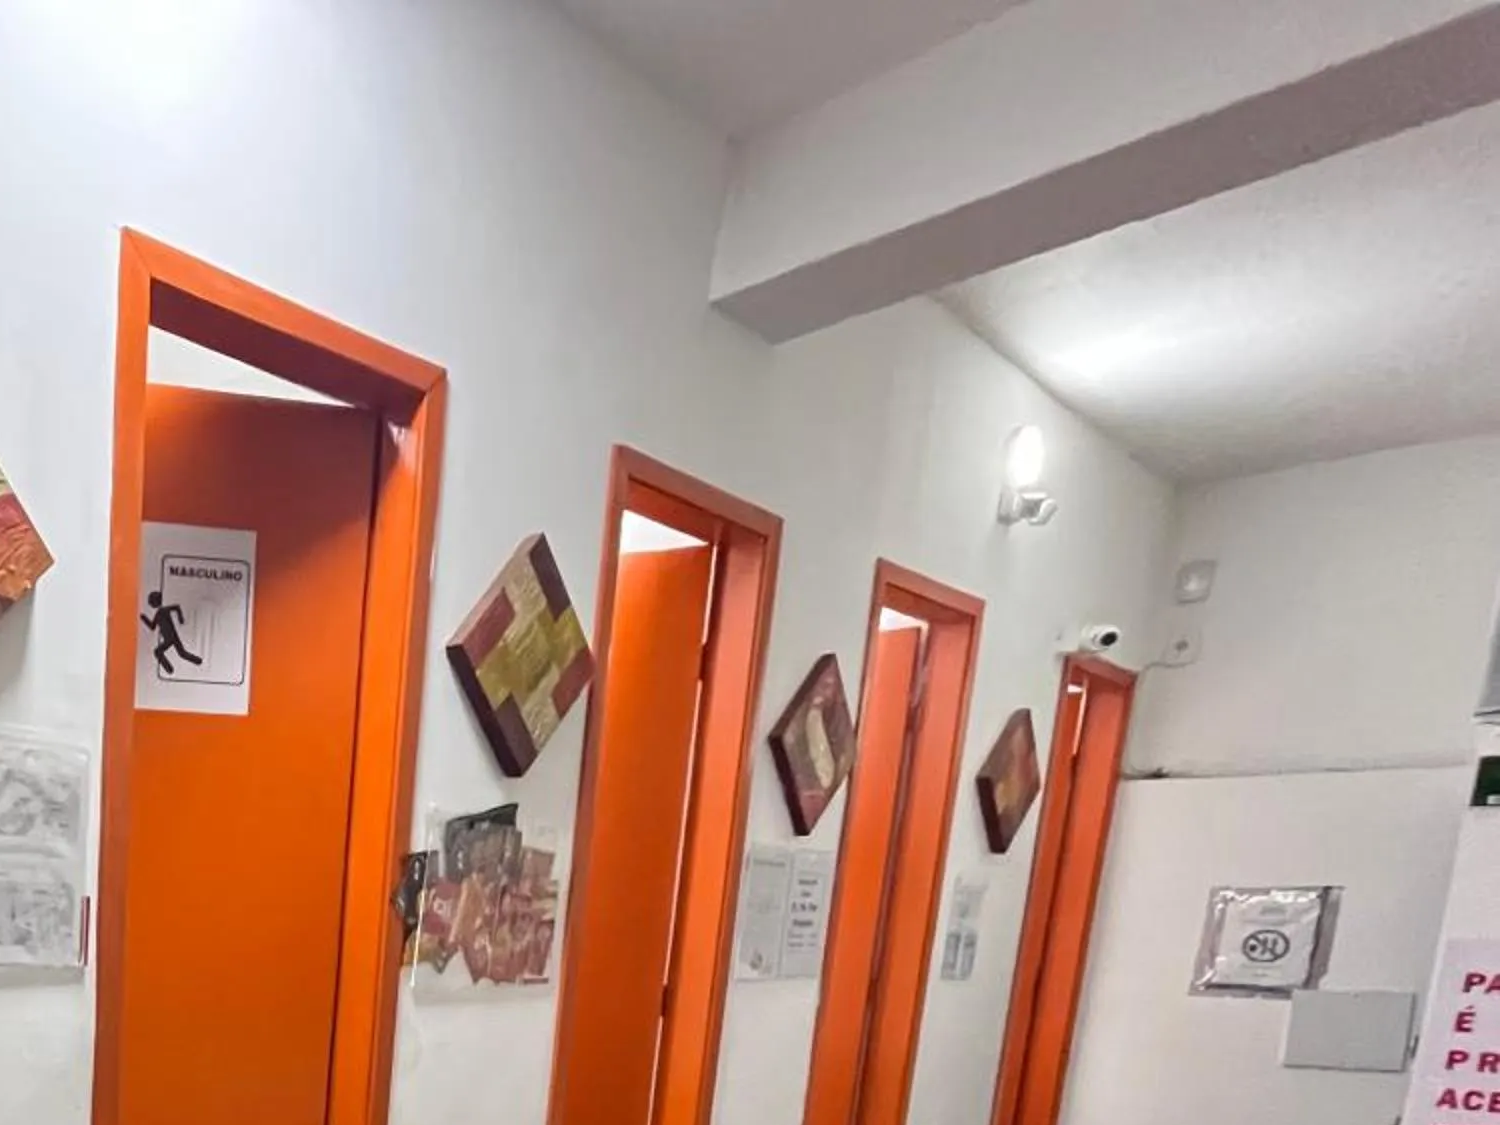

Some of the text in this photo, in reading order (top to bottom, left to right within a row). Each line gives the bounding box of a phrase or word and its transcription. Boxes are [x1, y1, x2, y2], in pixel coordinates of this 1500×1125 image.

[169, 565, 243, 582] MASCULINO
[1462, 972, 1500, 994] PA
[1453, 1004, 1477, 1033] É
[1435, 1087, 1500, 1113] ACE
